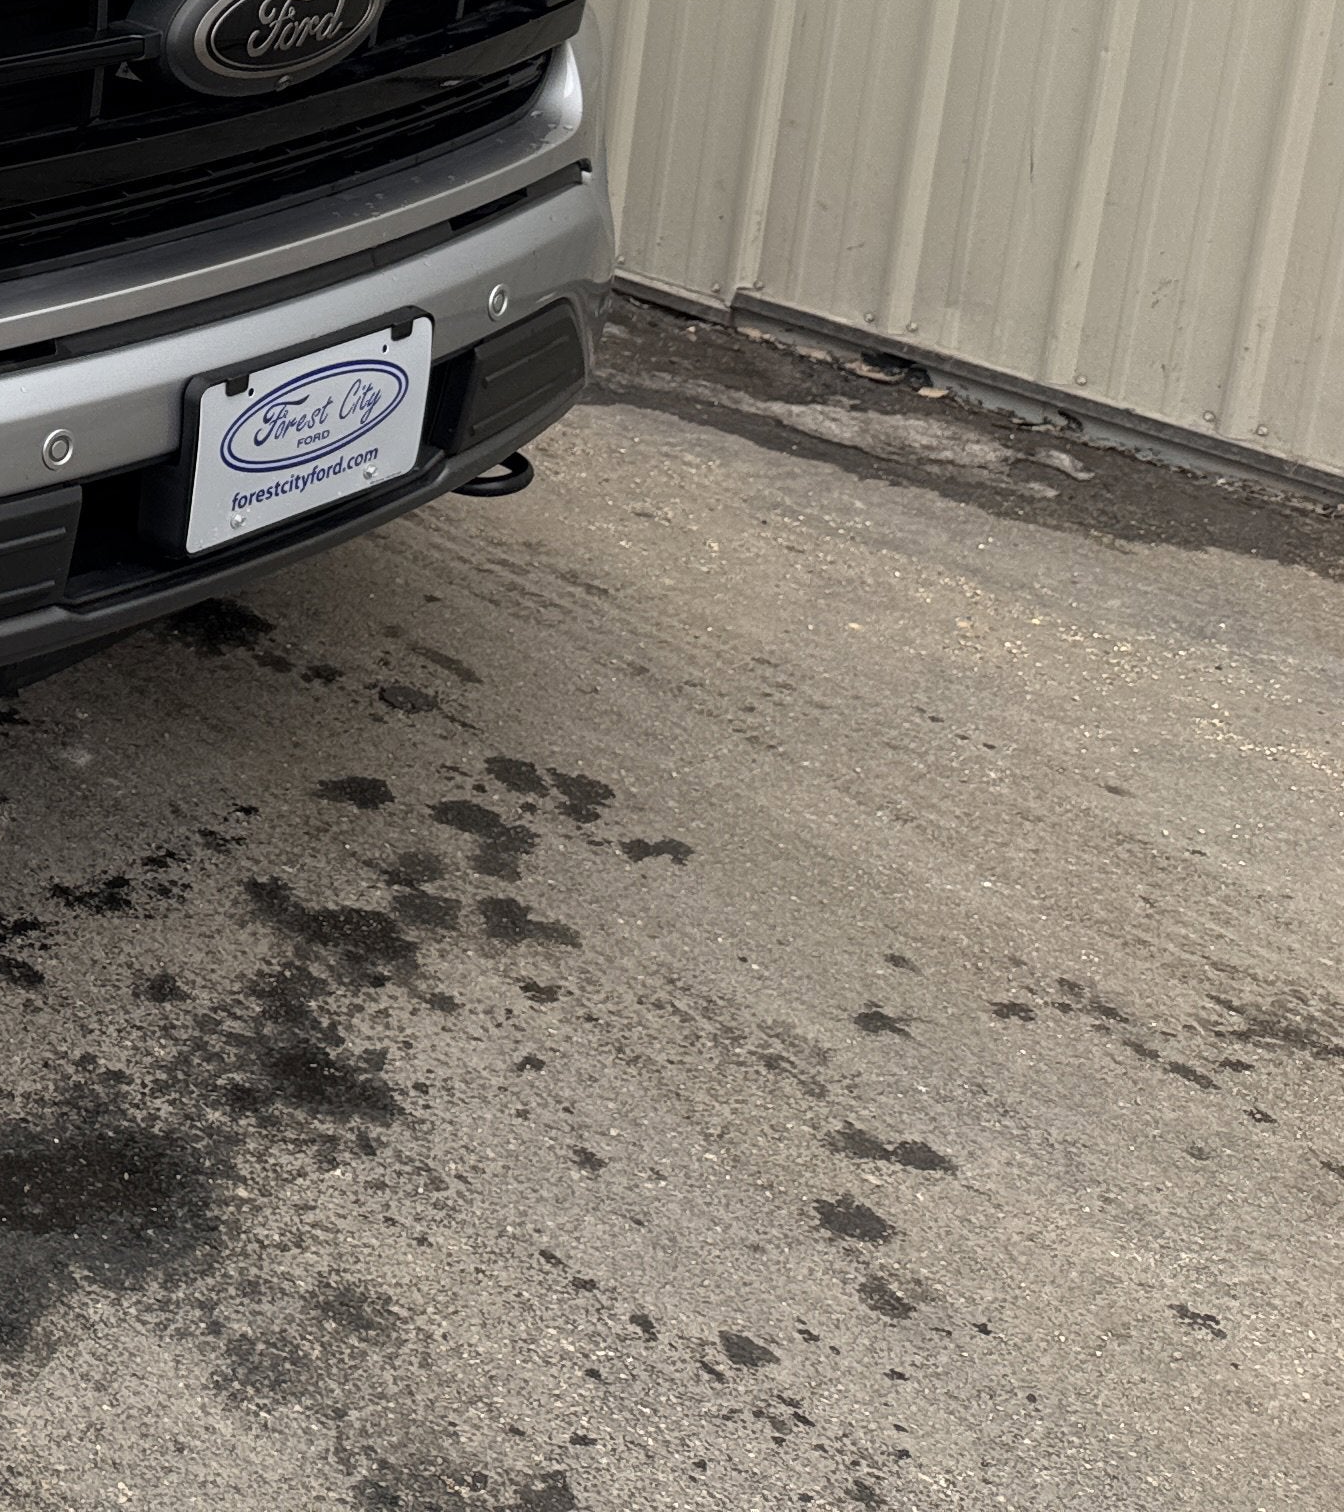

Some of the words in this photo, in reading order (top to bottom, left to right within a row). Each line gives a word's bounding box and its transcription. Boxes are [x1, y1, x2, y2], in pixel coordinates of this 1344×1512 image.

[252, 394, 333, 447] Forest
[338, 378, 382, 425] City
[296, 429, 330, 449] FORD
[231, 447, 379, 512] forestcityford.com
